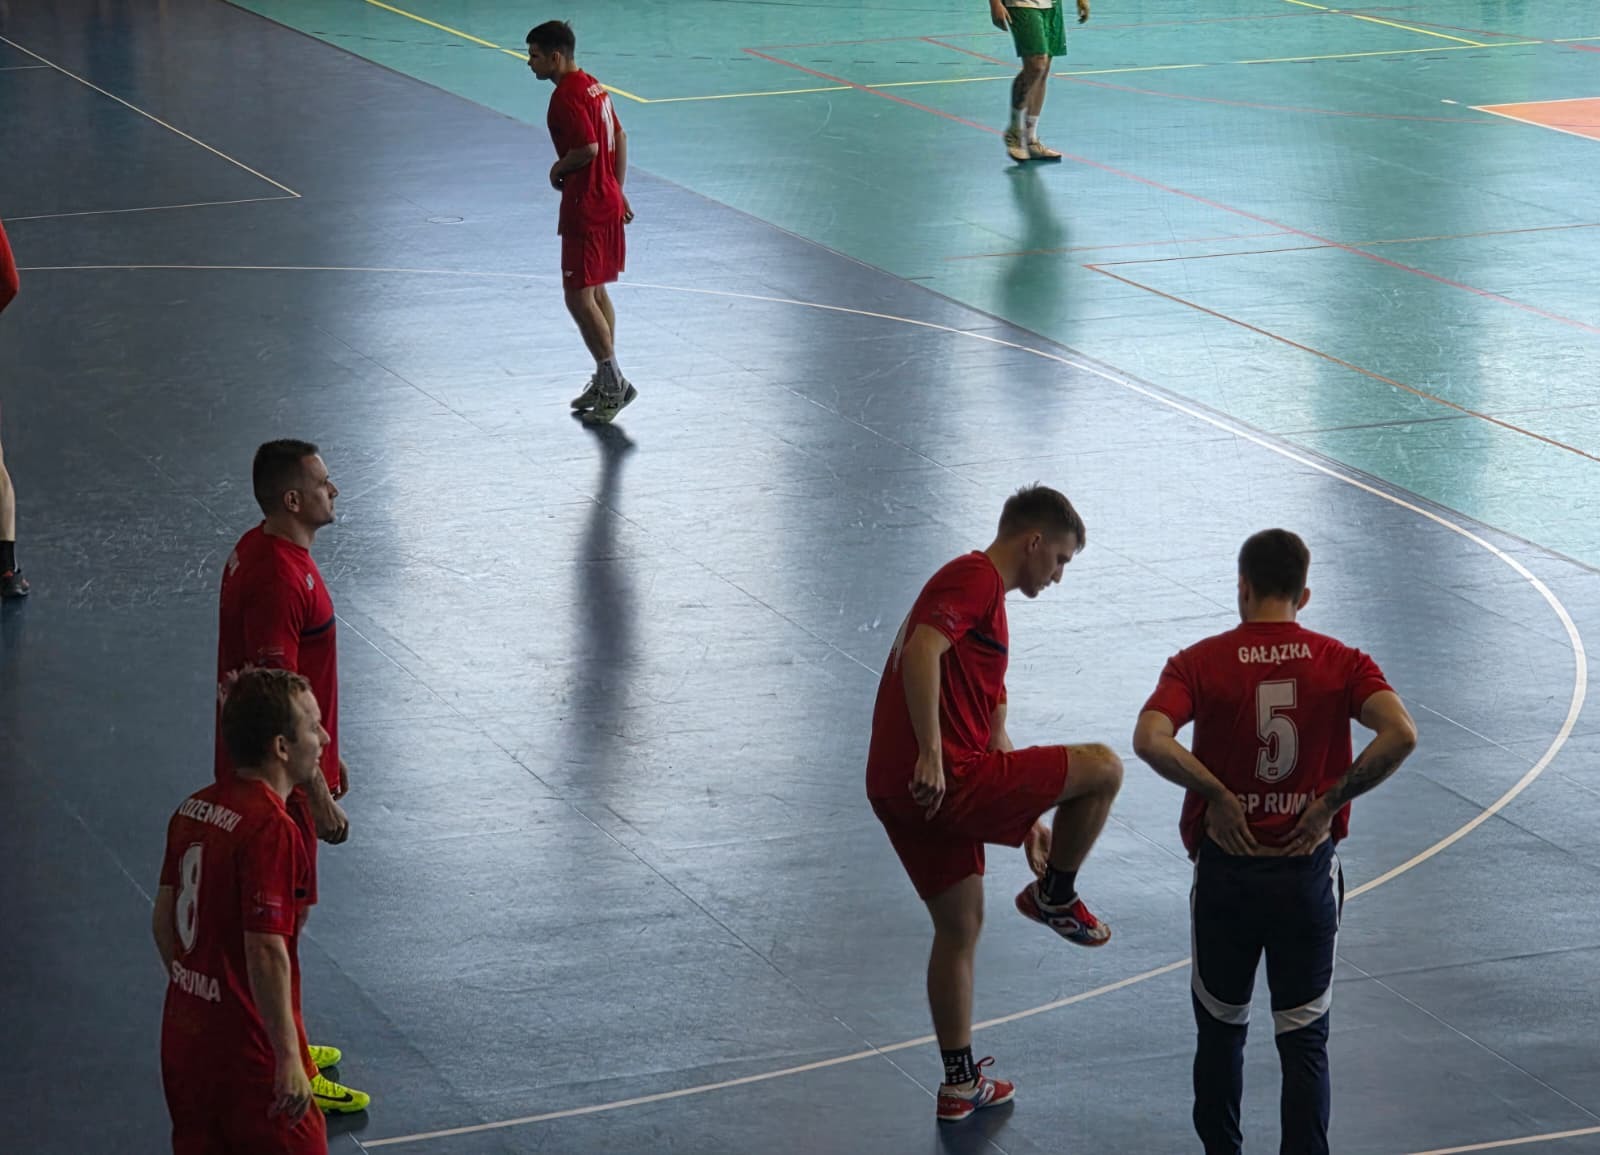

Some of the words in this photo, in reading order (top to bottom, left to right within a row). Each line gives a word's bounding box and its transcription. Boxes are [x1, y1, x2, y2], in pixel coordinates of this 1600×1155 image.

[1238, 643, 1312, 665] GAŁĄZKA
[1255, 678, 1300, 784] 5
[176, 842, 205, 954] 8
